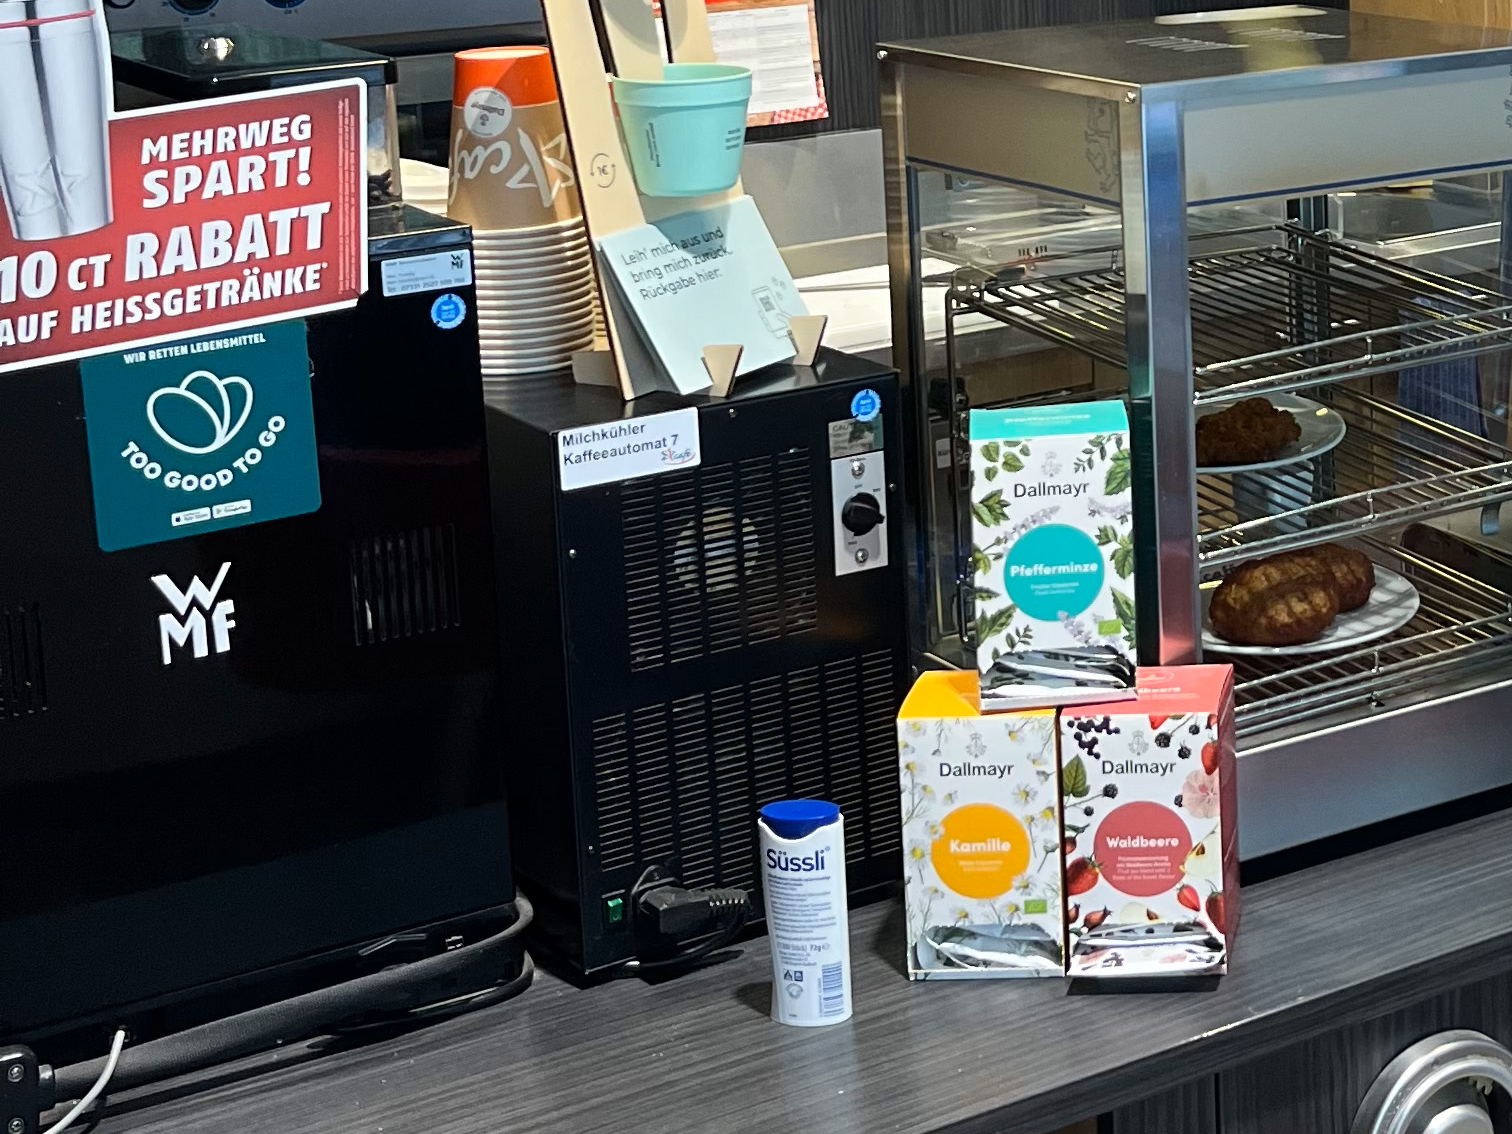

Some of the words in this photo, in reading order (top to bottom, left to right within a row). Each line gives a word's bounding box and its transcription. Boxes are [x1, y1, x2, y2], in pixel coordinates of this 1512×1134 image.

[140, 114, 312, 165] MEHRWEG
[142, 146, 312, 209] SPART!
[0, 250, 58, 304] 10
[125, 201, 331, 282] RABATT
[650, 241, 680, 257] mich
[680, 235, 701, 249] aus
[701, 226, 725, 243] und
[630, 266, 664, 284] bring
[663, 256, 693, 273] mich
[639, 275, 697, 301] Rückgabe
[695, 268, 724, 284] hier.
[0, 308, 59, 348] AUF
[123, 350, 147, 364] WIR
[149, 345, 189, 362] RETTEN
[190, 332, 267, 354] LEBENSMITTEL
[562, 422, 647, 448] Milchkühler
[563, 437, 668, 466] Kaffeeautomat
[670, 434, 680, 447] 7
[120, 440, 163, 480] TOO
[163, 467, 234, 491] GOOD
[232, 447, 263, 474] TO
[258, 415, 287, 448] GO
[1013, 480, 1090, 499] Dallmayr
[1009, 561, 1099, 578] Pfefferminze
[939, 761, 1015, 779] Dallmayr
[1101, 759, 1177, 776] Dallmayr
[949, 837, 1012, 854] Kamille
[1105, 834, 1180, 849] Waldbeere
